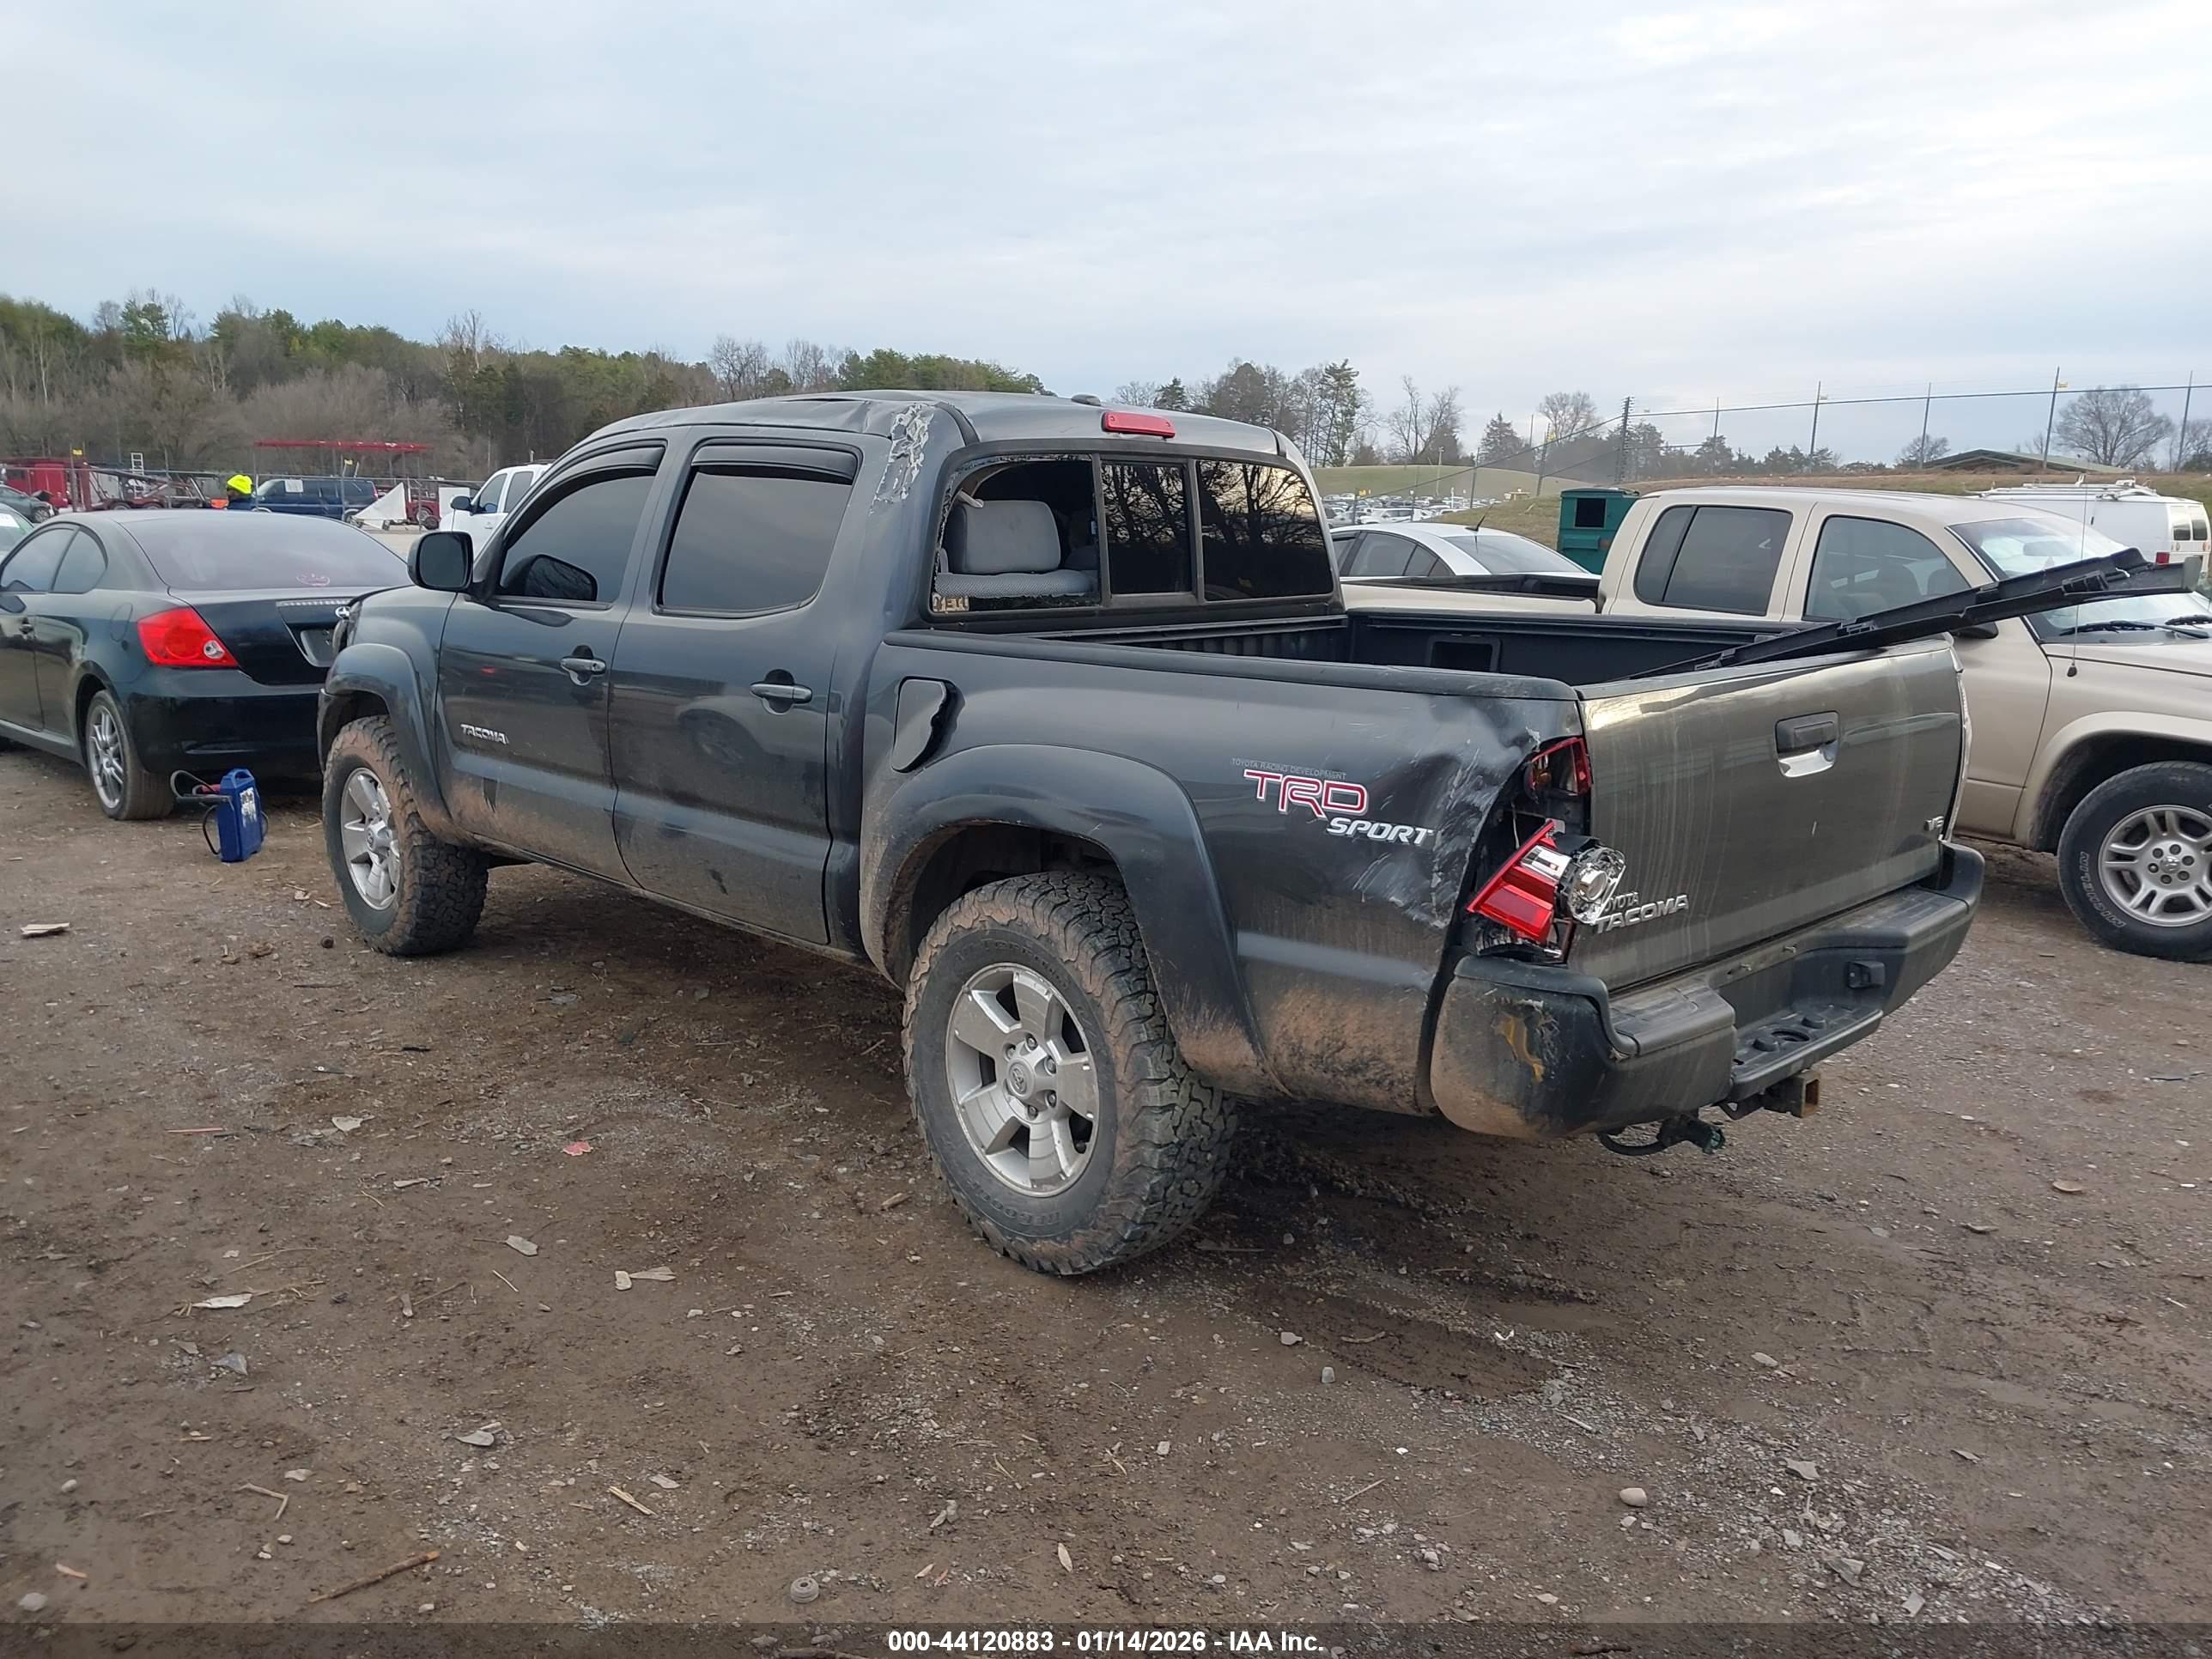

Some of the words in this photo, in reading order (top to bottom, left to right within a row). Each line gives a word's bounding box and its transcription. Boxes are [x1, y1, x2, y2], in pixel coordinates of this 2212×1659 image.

[460, 723, 509, 744] TACOMA
[1231, 757, 1258, 769] TOYOTA
[1259, 760, 1289, 773] RACING
[1289, 763, 1347, 781] DEVELOPMENT
[1243, 769, 1370, 820] TRD
[1326, 817, 1435, 847] SPORT
[1604, 891, 1639, 913] OYOTA
[2079, 851, 2127, 928] MICHELIN
[1595, 894, 1689, 934] TACOMA
